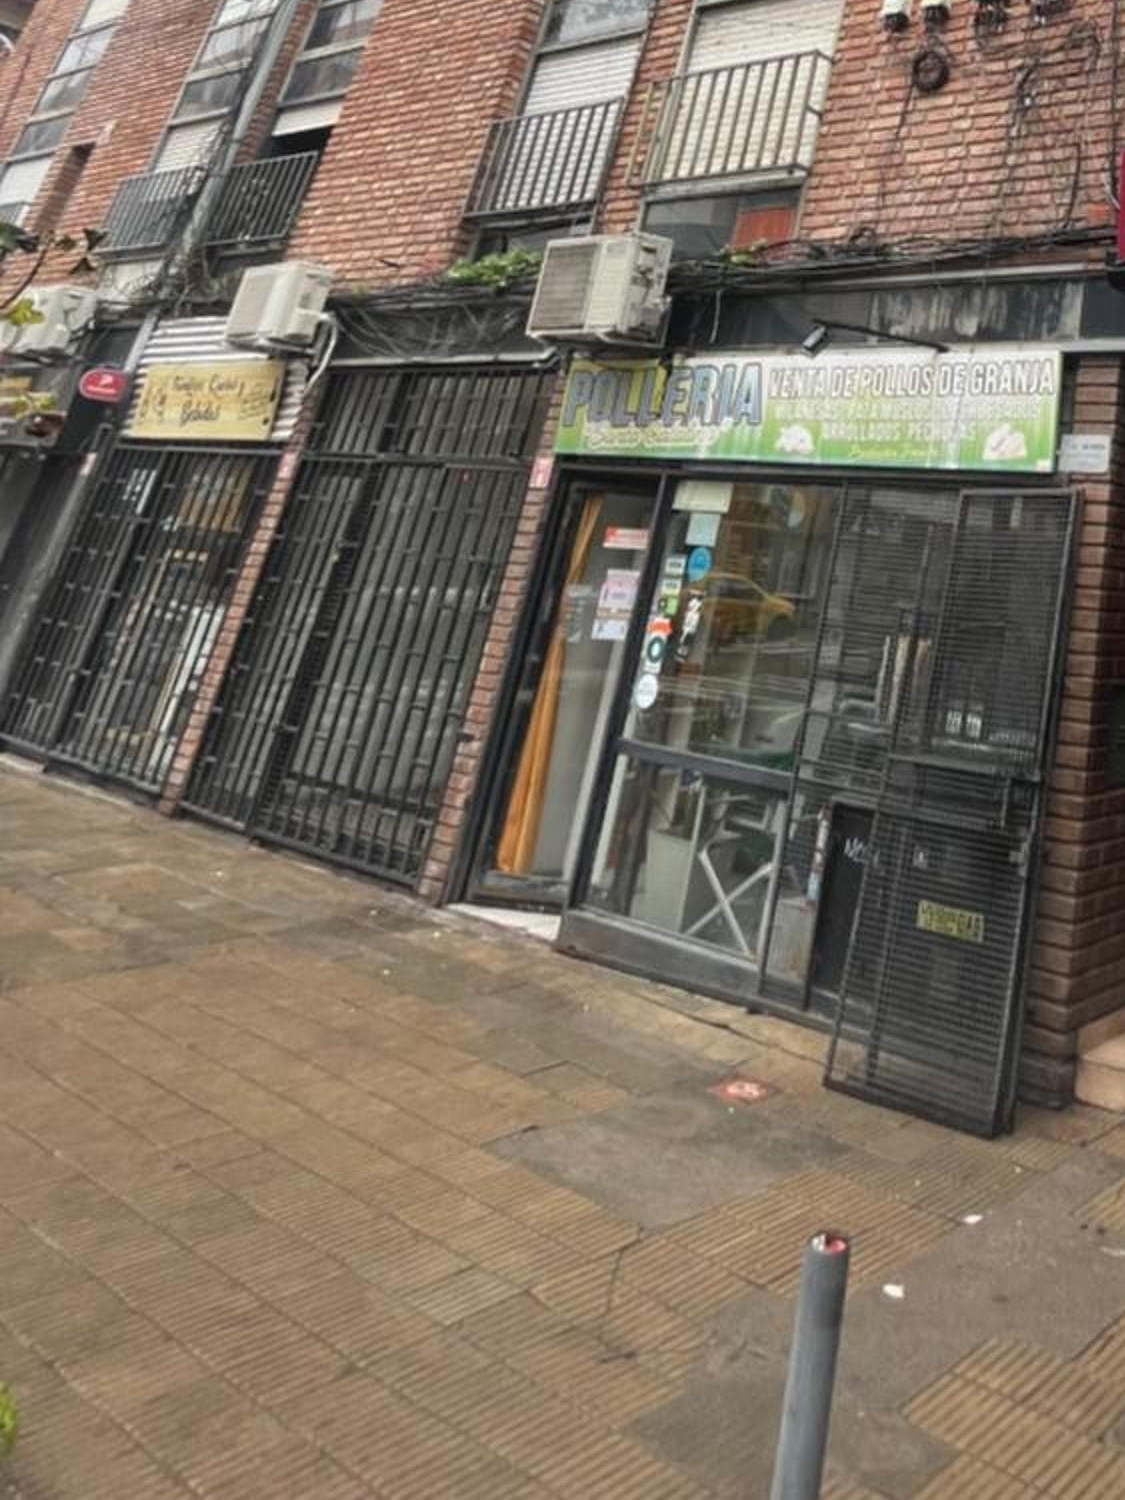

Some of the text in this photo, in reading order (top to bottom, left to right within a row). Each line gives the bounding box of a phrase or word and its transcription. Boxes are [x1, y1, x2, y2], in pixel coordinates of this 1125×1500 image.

[562, 362, 762, 428] POLLERIA
[768, 358, 1056, 400] VENTA DE POLLOS DE GRANJA
